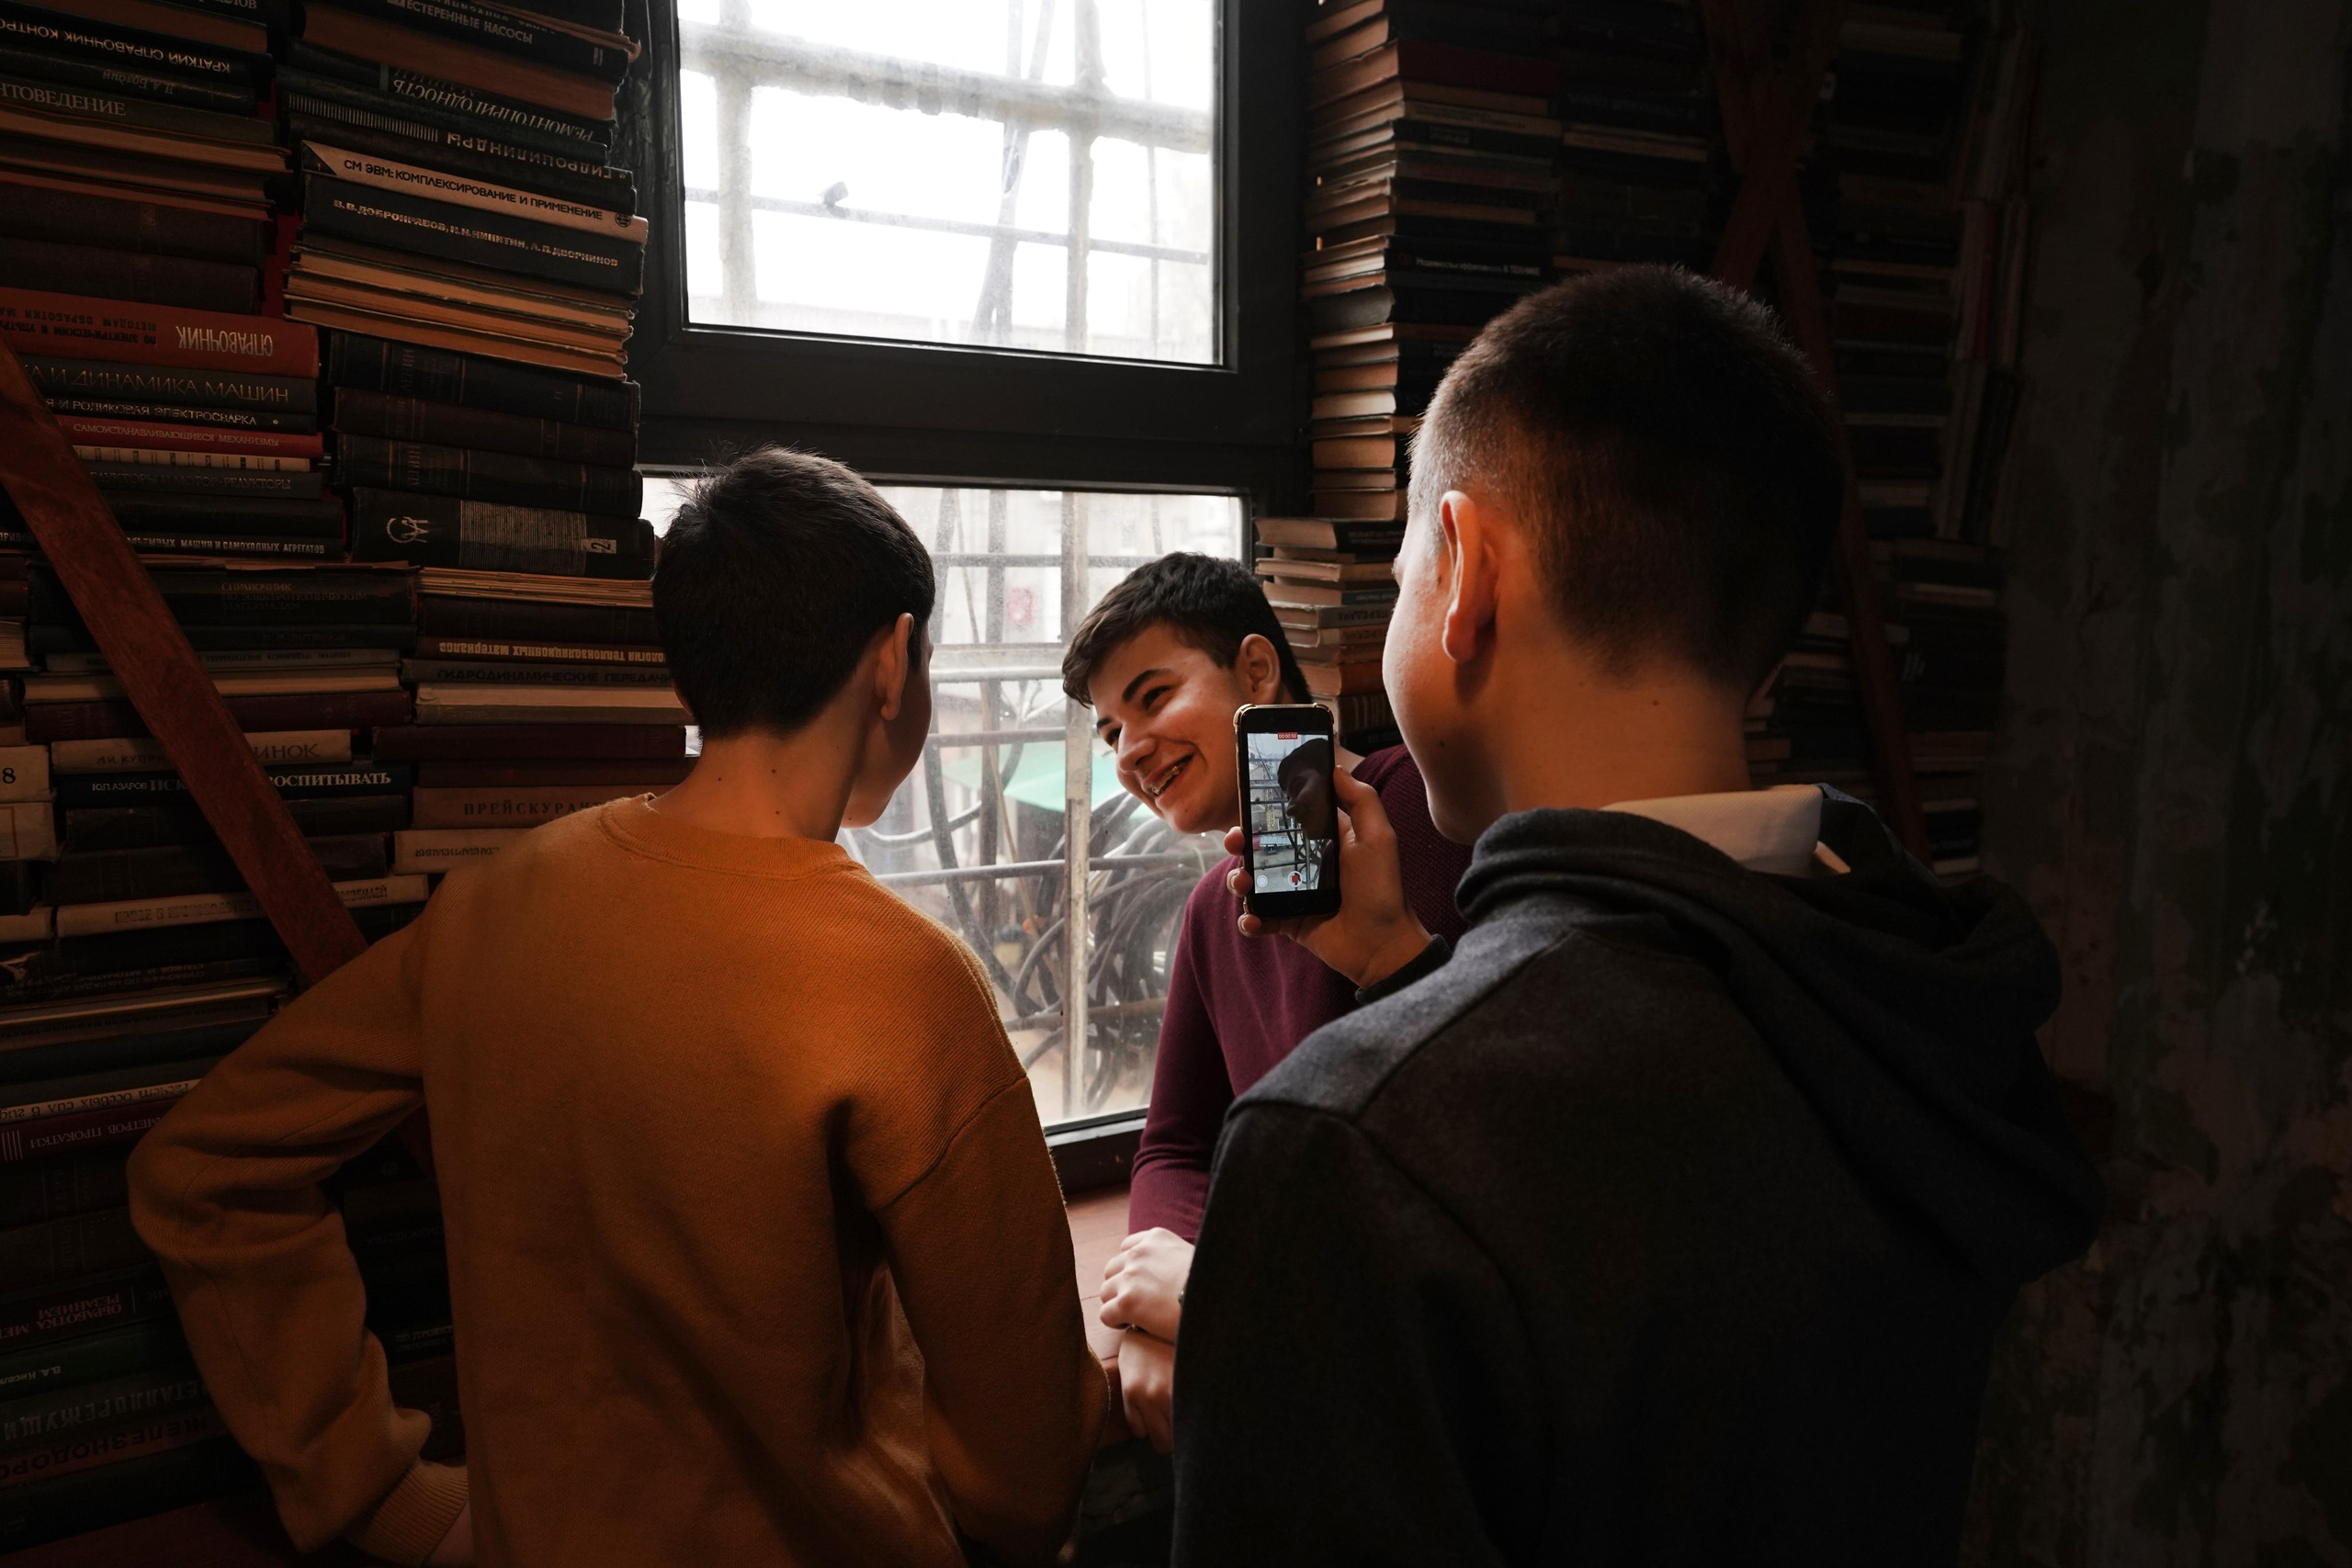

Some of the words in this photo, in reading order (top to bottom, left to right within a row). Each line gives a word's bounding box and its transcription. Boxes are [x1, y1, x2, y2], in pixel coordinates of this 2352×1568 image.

[483, 21, 533, 44] НАСОСЫ
[64, 32, 164, 61] СПРАВОЧНИК
[168, 51, 230, 73] КРАТКИЙ
[392, 78, 594, 142] РЕМОНТОПРИГОДНОСТЬ
[447, 131, 613, 180] ГИДРОЦИЛИНДРЫ
[344, 159, 363, 174] СМ
[366, 164, 395, 179] ЭВМ:
[395, 170, 516, 204] КОМПЛЕКСИРОВАНИЕ
[519, 194, 528, 205] И
[530, 197, 603, 221] ПРИМЕНЕНИЕ
[0, 306, 17, 318] МА
[25, 310, 93, 326] ОБРАБОТКИ
[53, 326, 139, 344] ЭЛЕКТРИЧЕСКИМ
[103, 318, 156, 333] МЕТОДАМ
[175, 325, 274, 357] СПРАВОЧНИК
[51, 367, 67, 386] И
[70, 369, 199, 397] ДИНАМИКА
[205, 379, 288, 403] МАШИН
[60, 400, 69, 410] И
[73, 400, 150, 416] РОЛИКОВАЯ
[74, 423, 215, 443] САМОУСТАНАВЛИВАЮЩИЕСЯ
[219, 434, 279, 447] МЕХАНИЗМЫ
[181, 539, 214, 549] МАШИН
[222, 542, 279, 552] САМОХОДНЫХ
[283, 544, 324, 554] АГРЕГАТОВ
[439, 641, 510, 656] материалов
[513, 645, 626, 661] теплоизоляционных
[437, 669, 599, 682] ГИДРОДИНАМИЧЕСКИЕ
[120, 753, 169, 765] КУПРИ
[254, 741, 320, 761] ИНОК
[2, 767, 17, 784] 8
[112, 780, 147, 792] АЗАРОВ
[150, 778, 187, 792] ИСК
[268, 773, 392, 788] ОСПИТЫВАТЬ
[464, 798, 601, 816] ПРЕЙСКУРАН
[107, 1115, 163, 1134] МЕТРОВ
[28, 1125, 102, 1149] ПРОКАТКИ
[37, 1292, 120, 1321] РЕЗАНИЕМ
[35, 1302, 124, 1331] ОБРАБОТКА
[4, 1380, 209, 1442] ЕТАЛЛОРЕЖУЩИ
